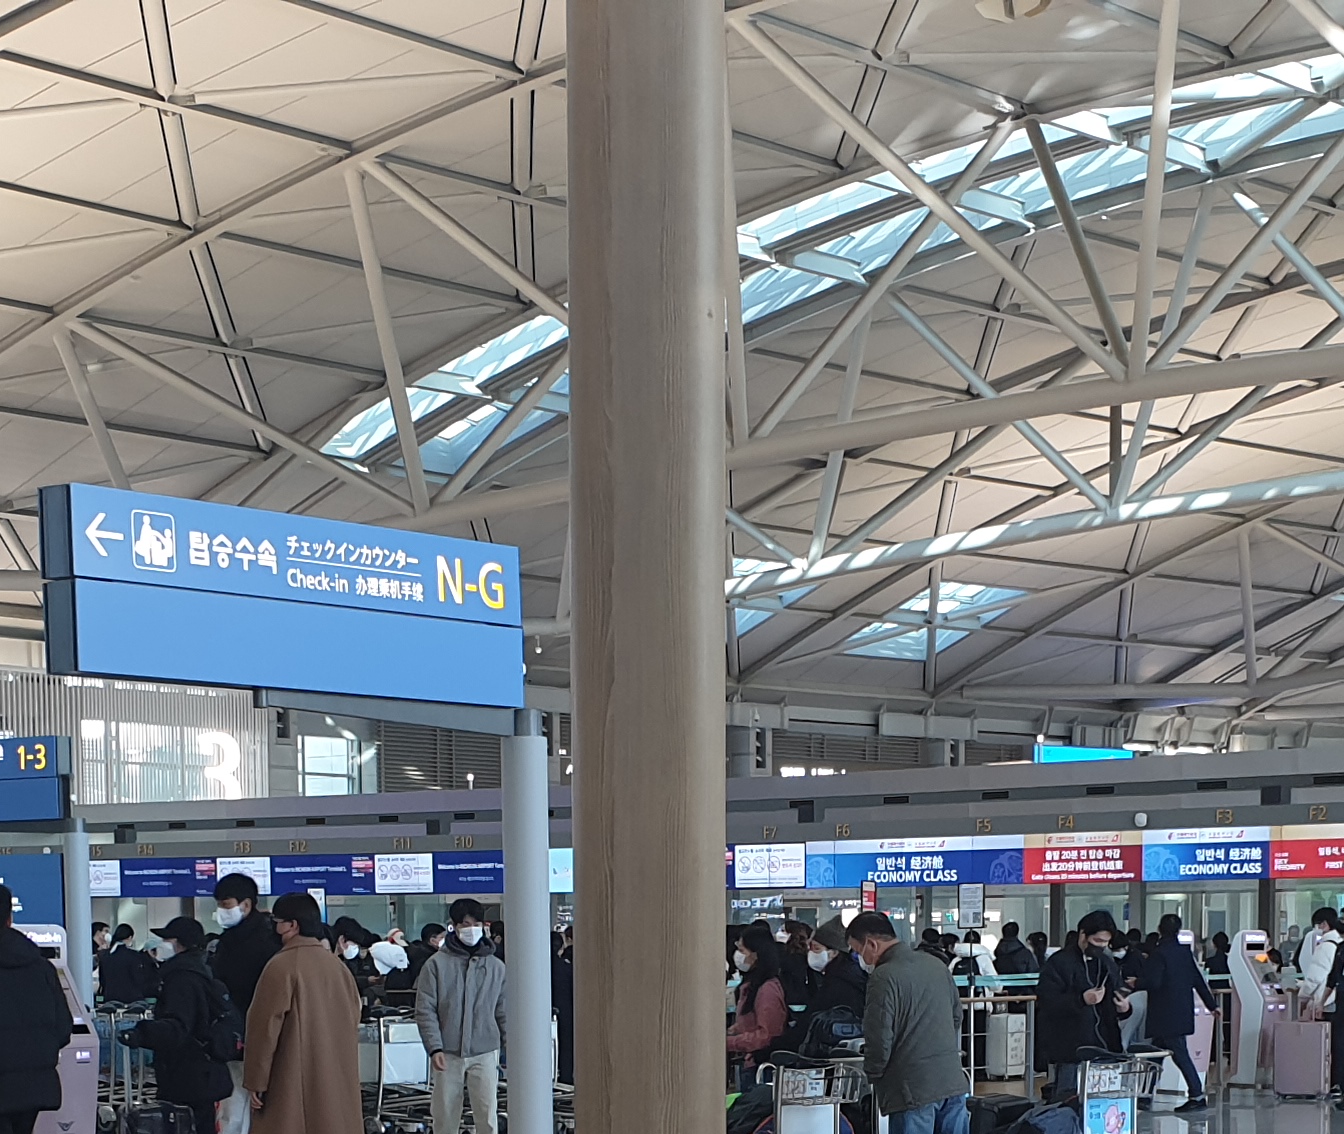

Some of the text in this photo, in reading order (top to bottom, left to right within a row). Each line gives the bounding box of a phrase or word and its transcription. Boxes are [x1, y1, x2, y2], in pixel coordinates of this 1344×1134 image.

[189, 530, 278, 574] 탑승수속
[286, 534, 419, 570] チェックインカウンター
[287, 568, 424, 602] Check-in 办理乘机手续
[436, 554, 504, 609] N-G
[17, 743, 47, 770] 1-3
[1216, 808, 1234, 824] F3
[1309, 805, 1328, 820] F2
[976, 818, 992, 832] F5
[1058, 815, 1074, 829] F4
[763, 826, 778, 839] F7
[836, 824, 850, 837] F6
[234, 842, 251, 853] F13
[289, 840, 307, 852] F12
[393, 837, 412, 849] F11
[454, 836, 473, 848] F10
[137, 844, 154, 856] F14
[1195, 847, 1262, 861] 일반석 经济舱
[876, 855, 944, 870] 일반석 经济舱
[1180, 863, 1262, 875] ECONOMY CLASS
[868, 870, 957, 882] ECONOMY CLASS
[26, 932, 62, 943] Check-in
